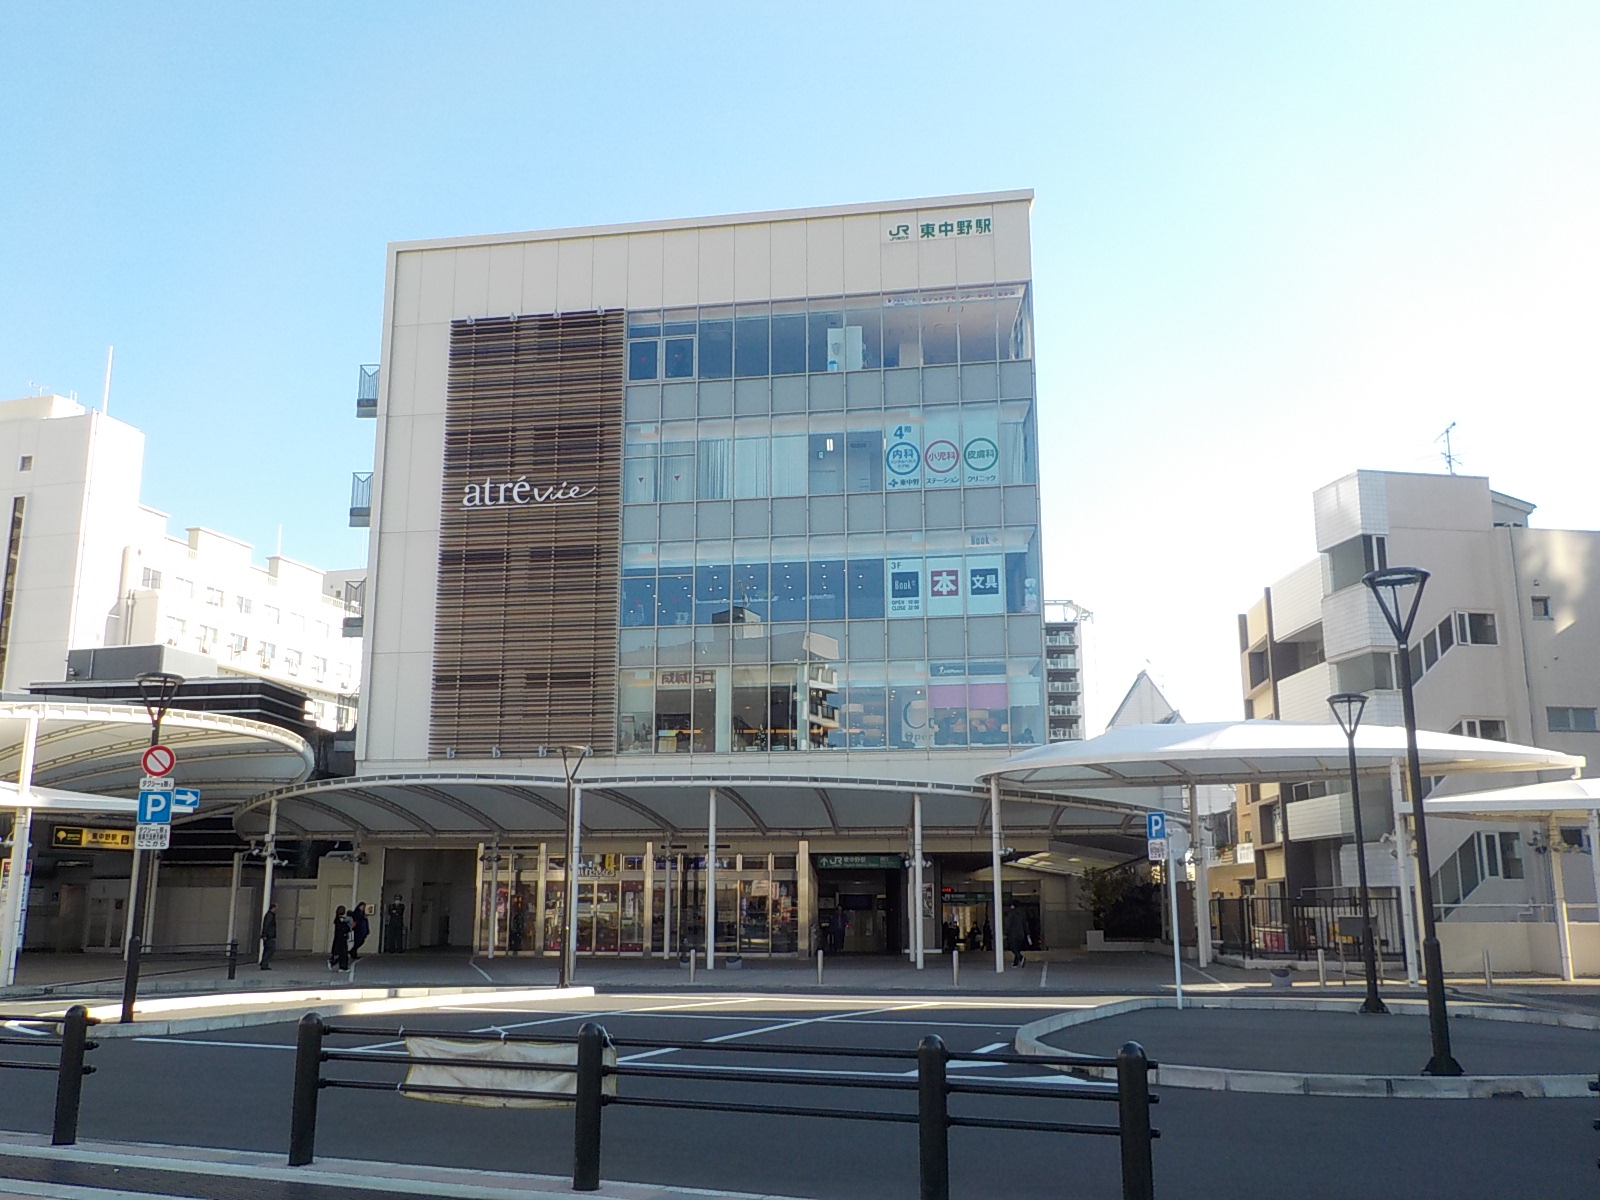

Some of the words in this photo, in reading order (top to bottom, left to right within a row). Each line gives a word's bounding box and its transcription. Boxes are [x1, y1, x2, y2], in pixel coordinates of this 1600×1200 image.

[889, 225, 910, 237] JR
[920, 218, 991, 238] 東中野駅
[893, 425, 912, 440] 4階
[892, 449, 914, 459] 内科
[928, 451, 956, 462] 小児科
[967, 449, 995, 460] 皮膚科
[900, 477, 920, 486] 東中野
[926, 476, 960, 484] ステーション
[967, 475, 996, 483] クリニック
[971, 534, 990, 545] Book
[891, 562, 902, 570] 3F
[932, 571, 957, 595] 本
[972, 575, 998, 590] 文具
[145, 794, 167, 821] P
[1151, 815, 1163, 837] P
[92, 832, 118, 841] 東中野駅
[137, 840, 167, 848] ここから
[830, 857, 843, 865] JR
